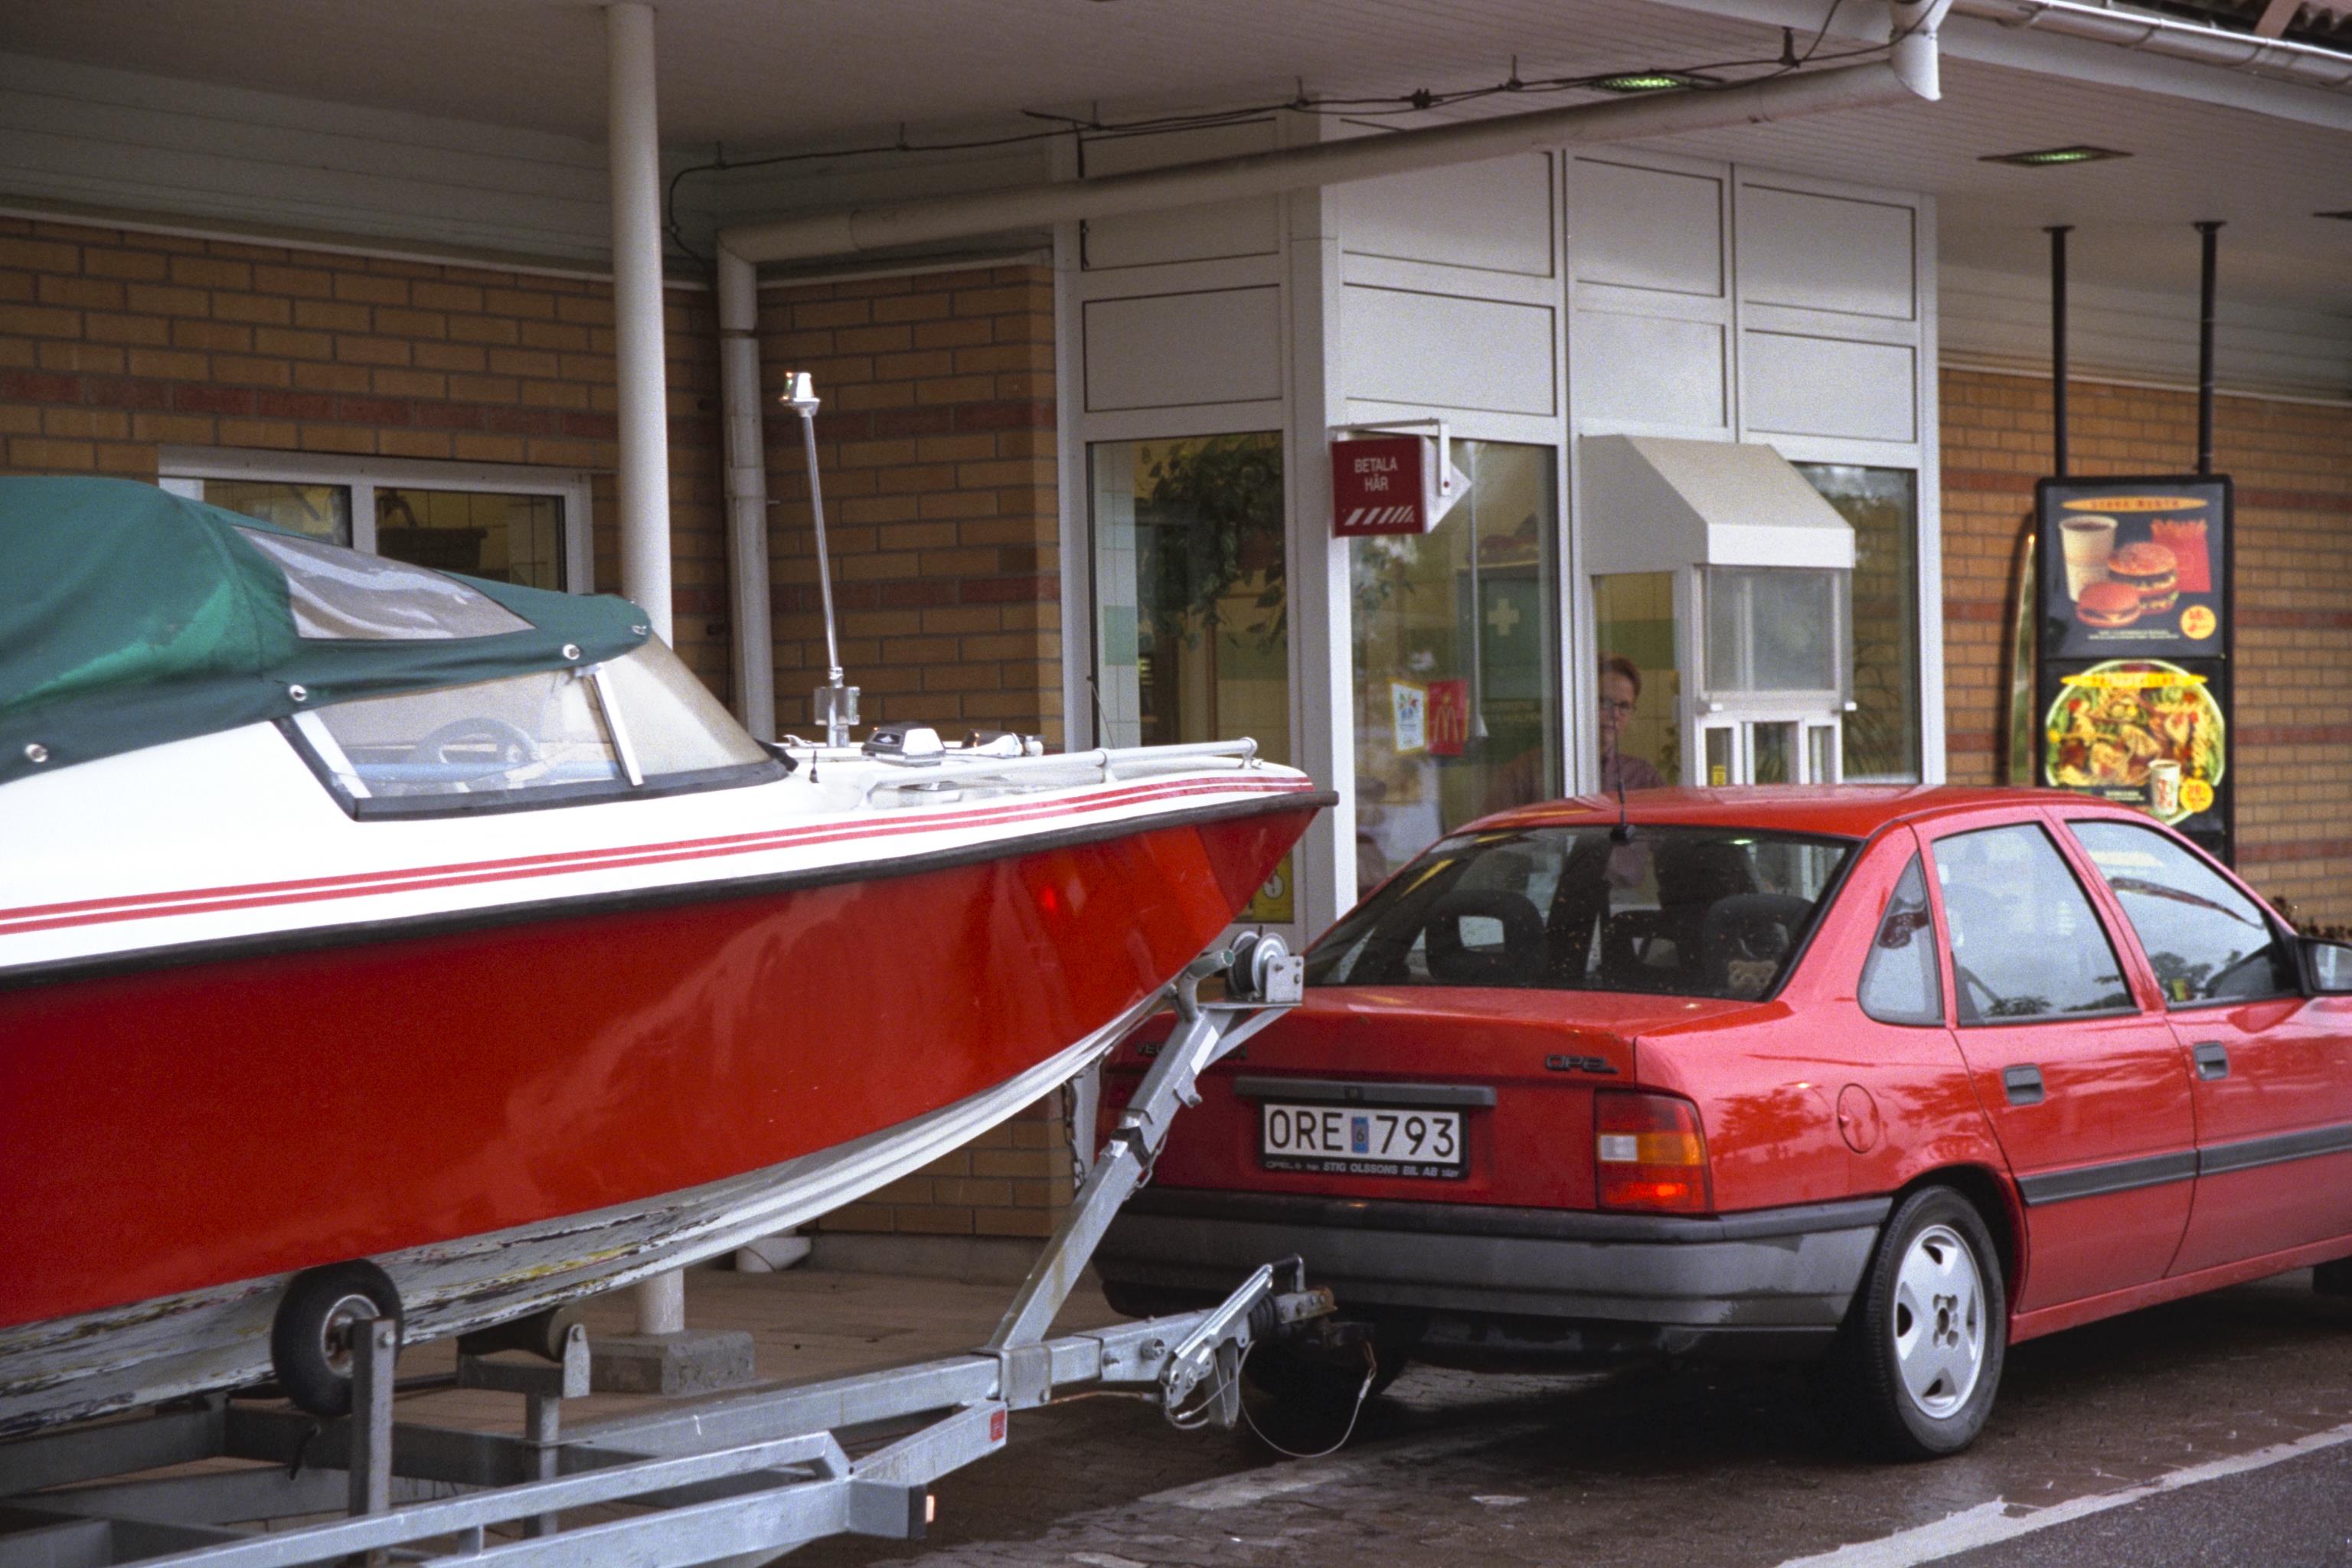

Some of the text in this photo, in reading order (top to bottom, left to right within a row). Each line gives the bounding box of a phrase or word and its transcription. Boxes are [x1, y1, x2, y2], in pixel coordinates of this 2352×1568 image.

[1354, 457, 1398, 473] BETALA
[1364, 473, 1389, 492] HÄR
[1545, 1054, 1618, 1074] OPEL
[1269, 1109, 1343, 1151] ORE
[1376, 1114, 1455, 1157] 793
[1323, 1161, 1346, 1172] STIG
[1350, 1163, 1398, 1174] OLSSONS
[1402, 1165, 1419, 1175] BIL
[1423, 1166, 1439, 1177] AB
